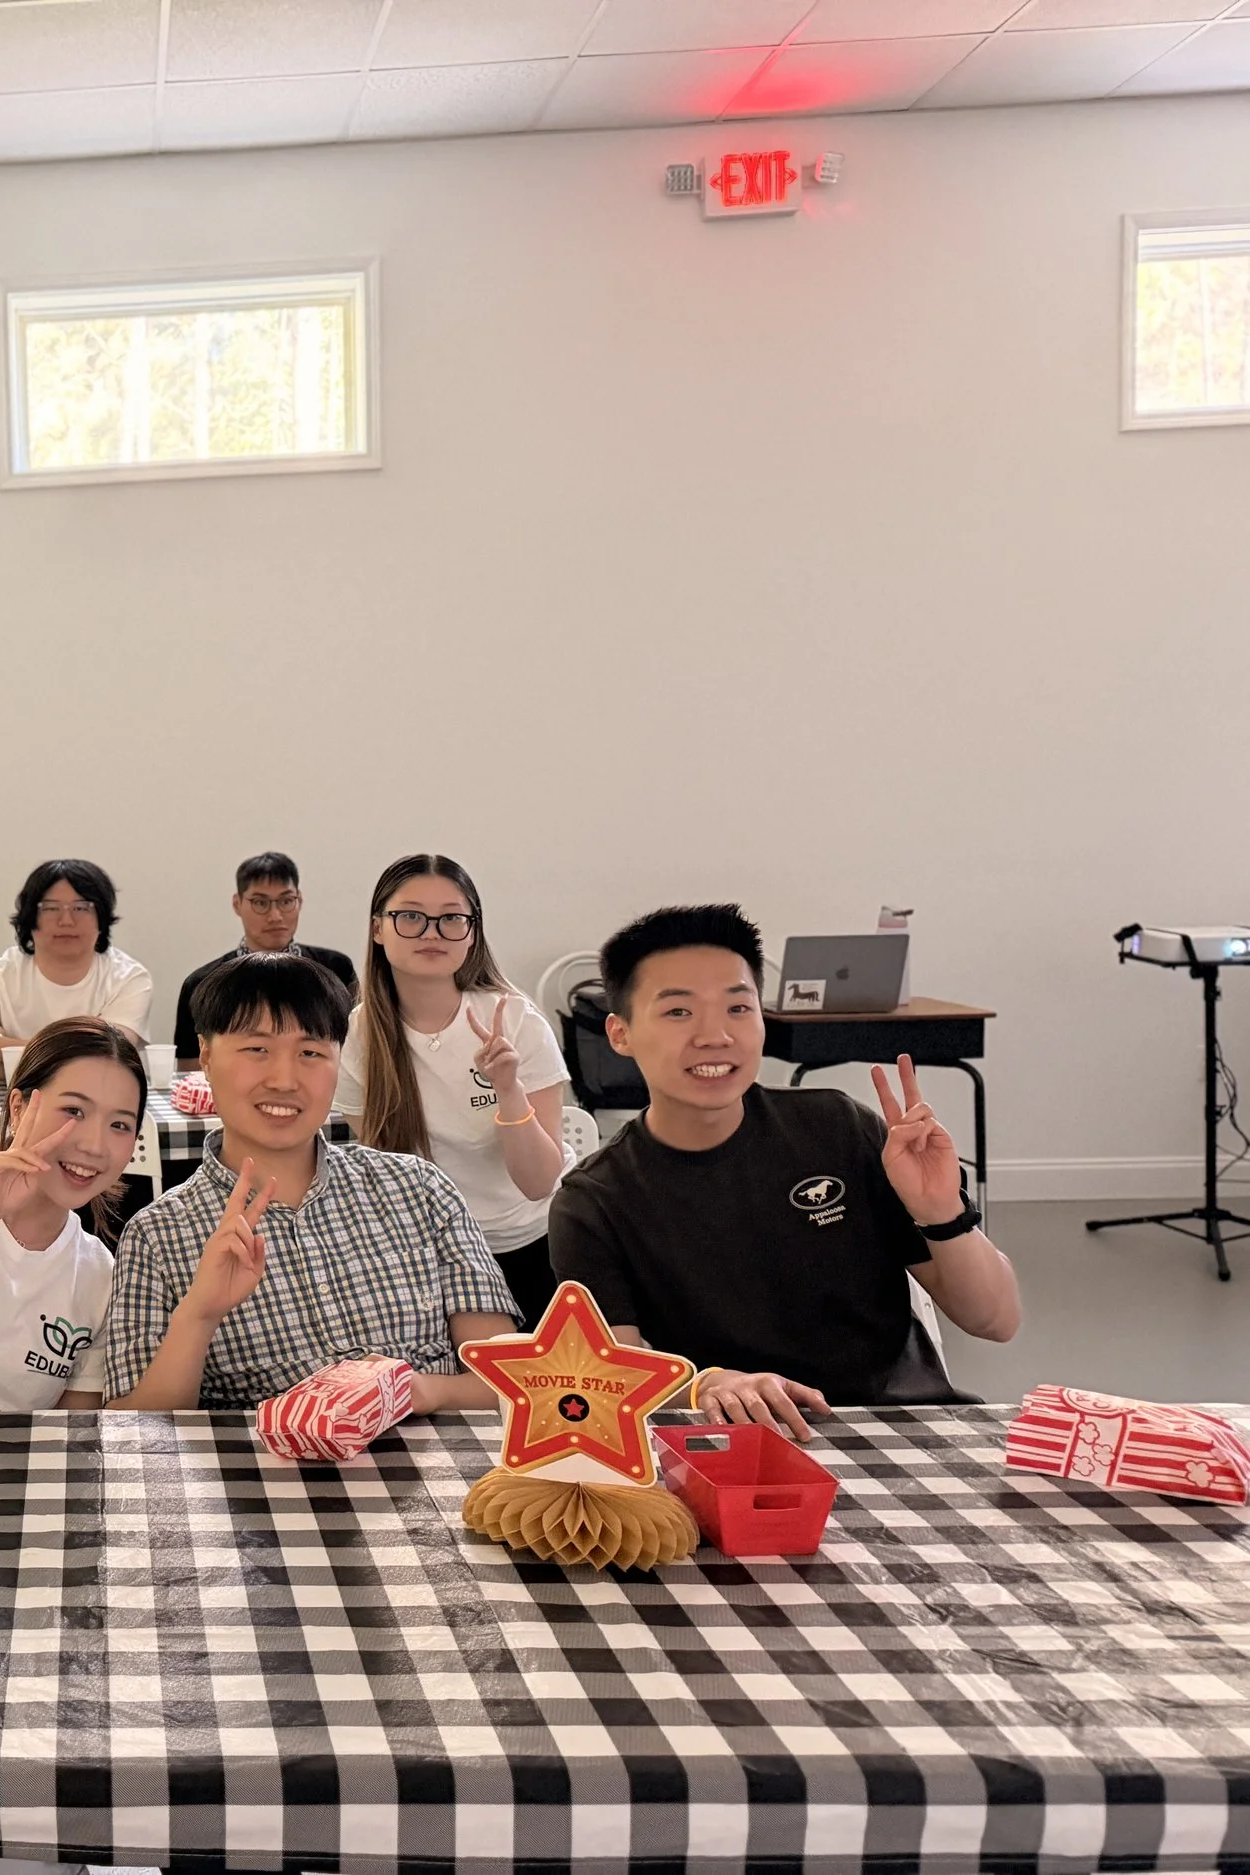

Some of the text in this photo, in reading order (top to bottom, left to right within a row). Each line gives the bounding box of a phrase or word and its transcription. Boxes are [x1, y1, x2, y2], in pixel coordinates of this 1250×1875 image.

[721, 151, 790, 206] EXIT
[809, 1205, 846, 1220] Appaloosa
[817, 1214, 844, 1226] Motors
[523, 1375, 625, 1396] MOVIE STAR
